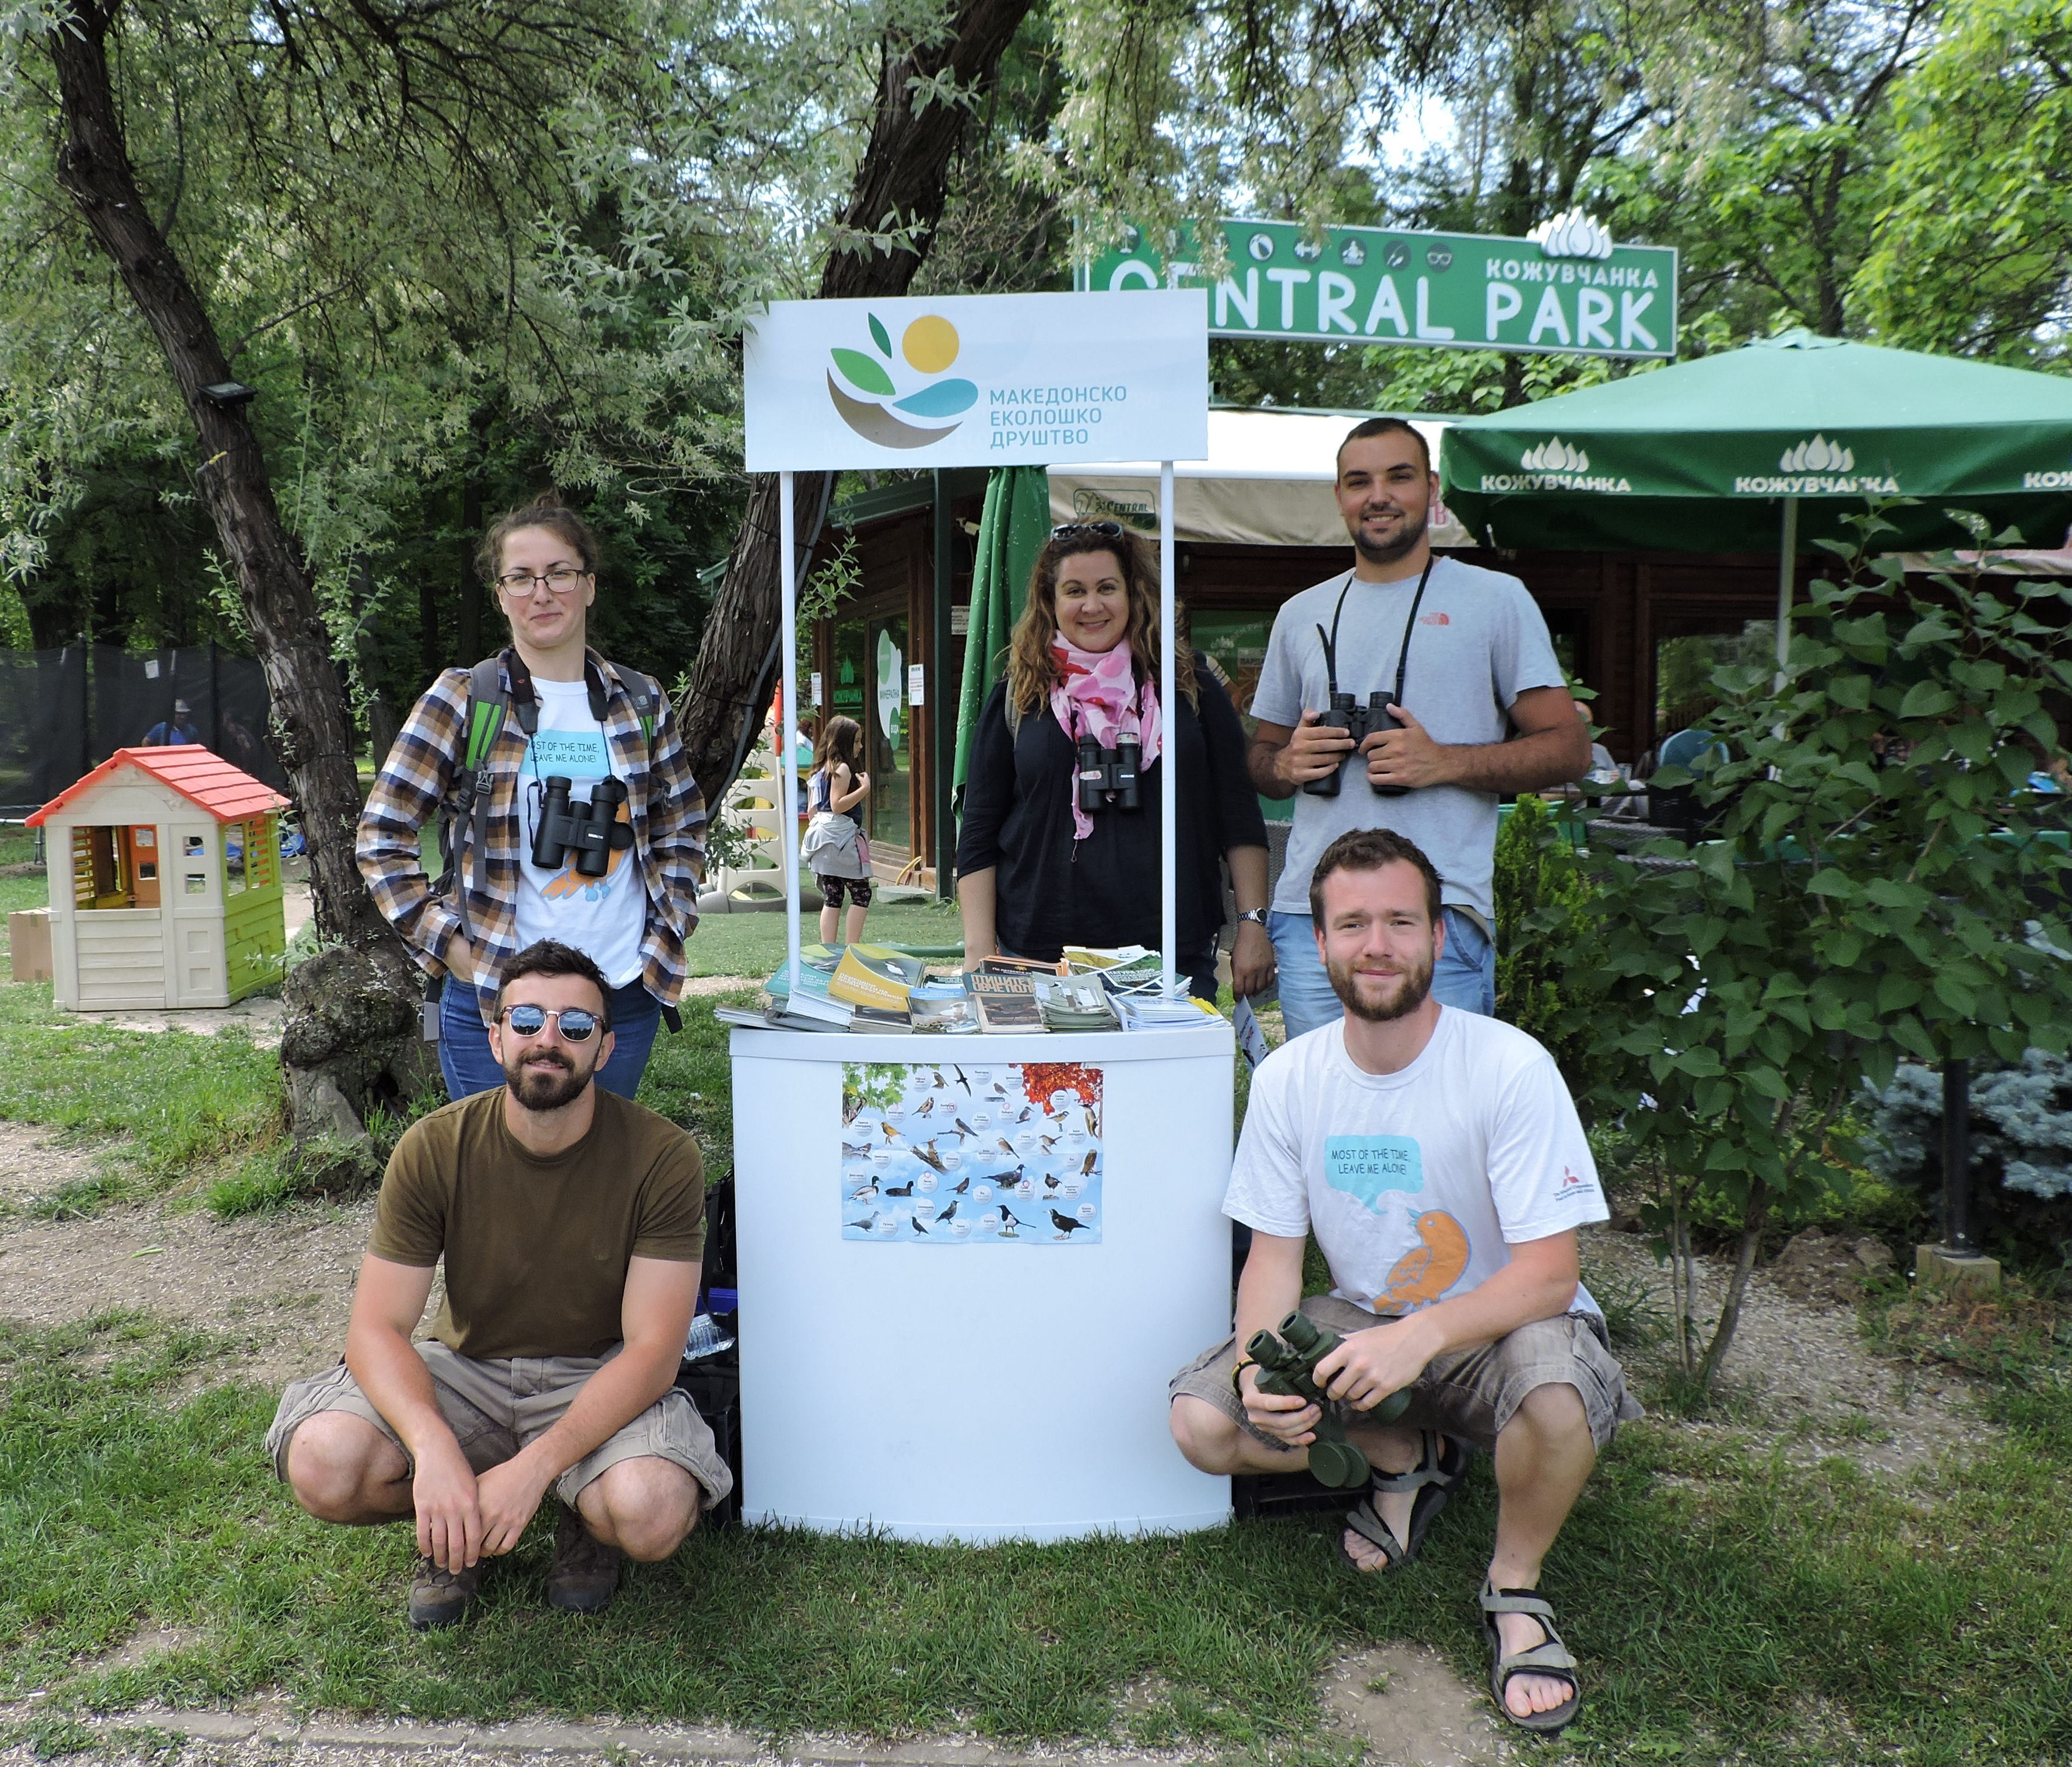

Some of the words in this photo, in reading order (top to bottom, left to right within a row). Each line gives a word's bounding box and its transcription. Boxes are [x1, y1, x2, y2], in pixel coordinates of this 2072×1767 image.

[1487, 258, 1658, 288] КОЖУВЧАНКА
[1486, 282, 1658, 350] PARK
[990, 386, 1127, 405] МАКЕДОНСКО
[991, 408, 1102, 426] ЕКОЛОШКО
[990, 429, 1089, 450] ДРУШТВО
[1481, 474, 1632, 492] КОЖУВЧАНКА
[1108, 501, 1148, 512] CENTRAL
[548, 742, 557, 751] OF
[560, 743, 575, 752] THE
[577, 743, 599, 753] TIME,
[531, 753, 553, 762] LEAVE
[556, 754, 567, 762] ME
[1332, 1149, 1356, 1160] MOST
[1358, 1149, 1368, 1160] OF
[1371, 1148, 1389, 1159] THE
[1339, 1163, 1365, 1175] LEAVE
[1367, 1163, 1379, 1175] ME
